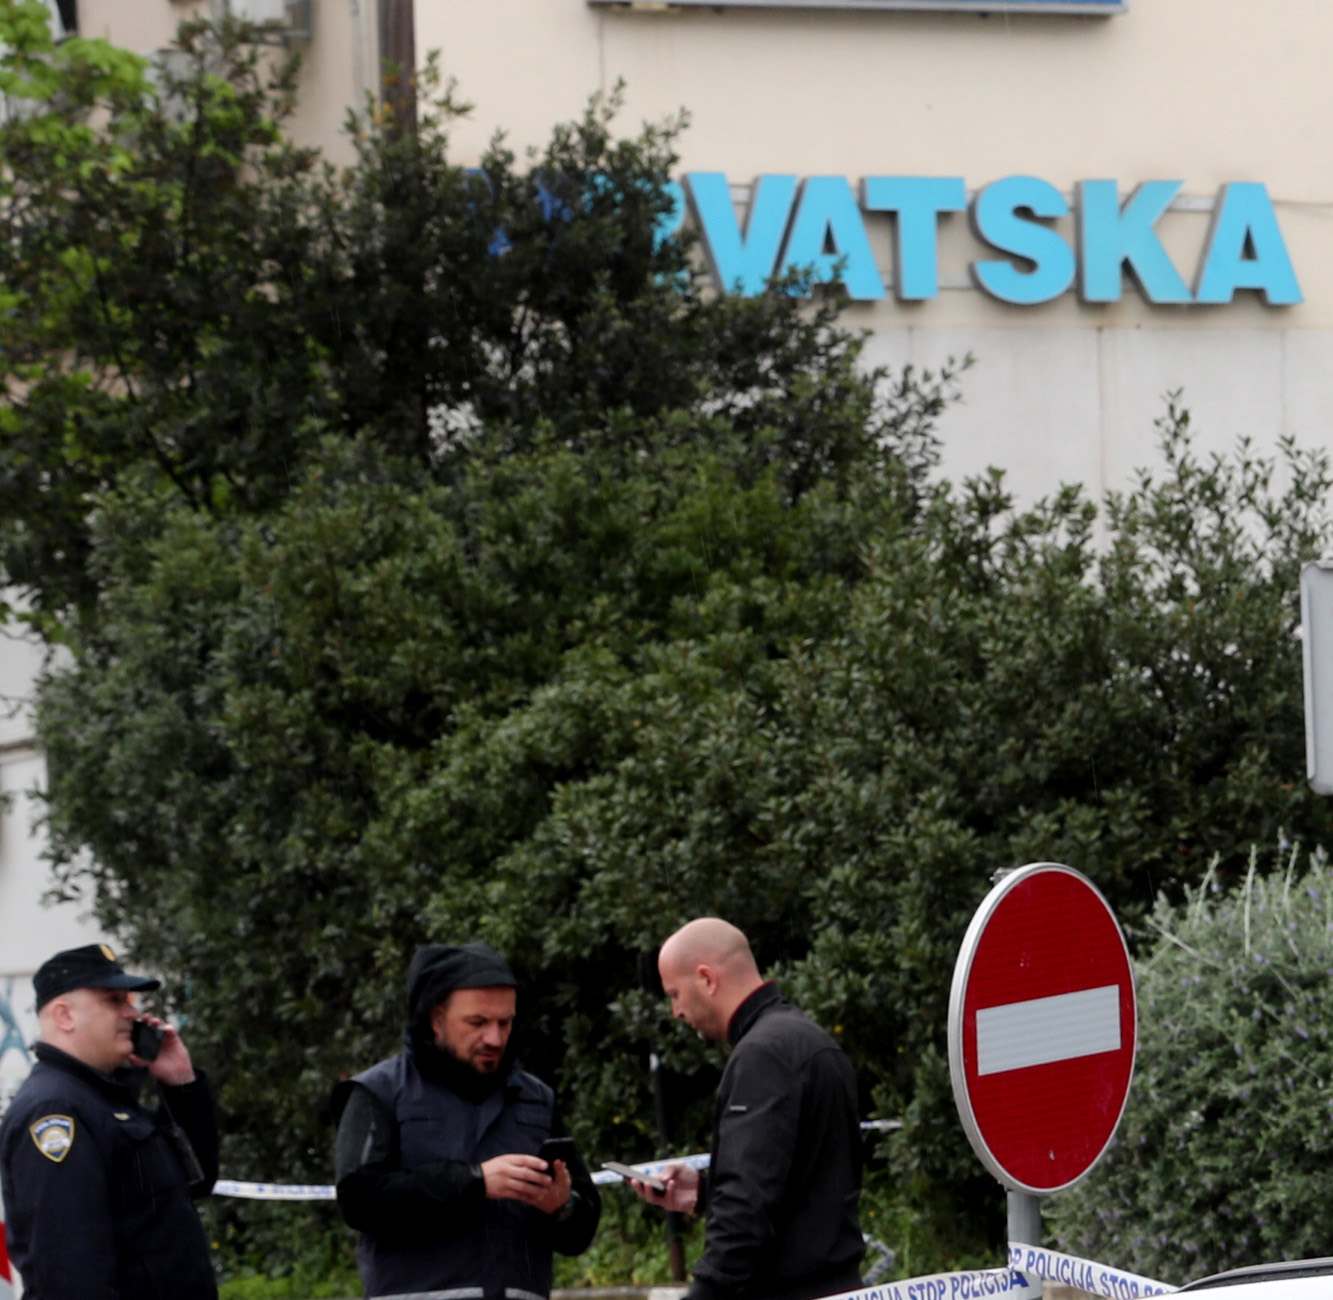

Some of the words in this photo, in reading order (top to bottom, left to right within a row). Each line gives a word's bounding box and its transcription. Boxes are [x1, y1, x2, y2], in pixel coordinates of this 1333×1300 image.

[463, 167, 1304, 306] VATSKA
[1027, 1251, 1096, 1293] POLICIJA
[1100, 1272, 1139, 1300] STOP
